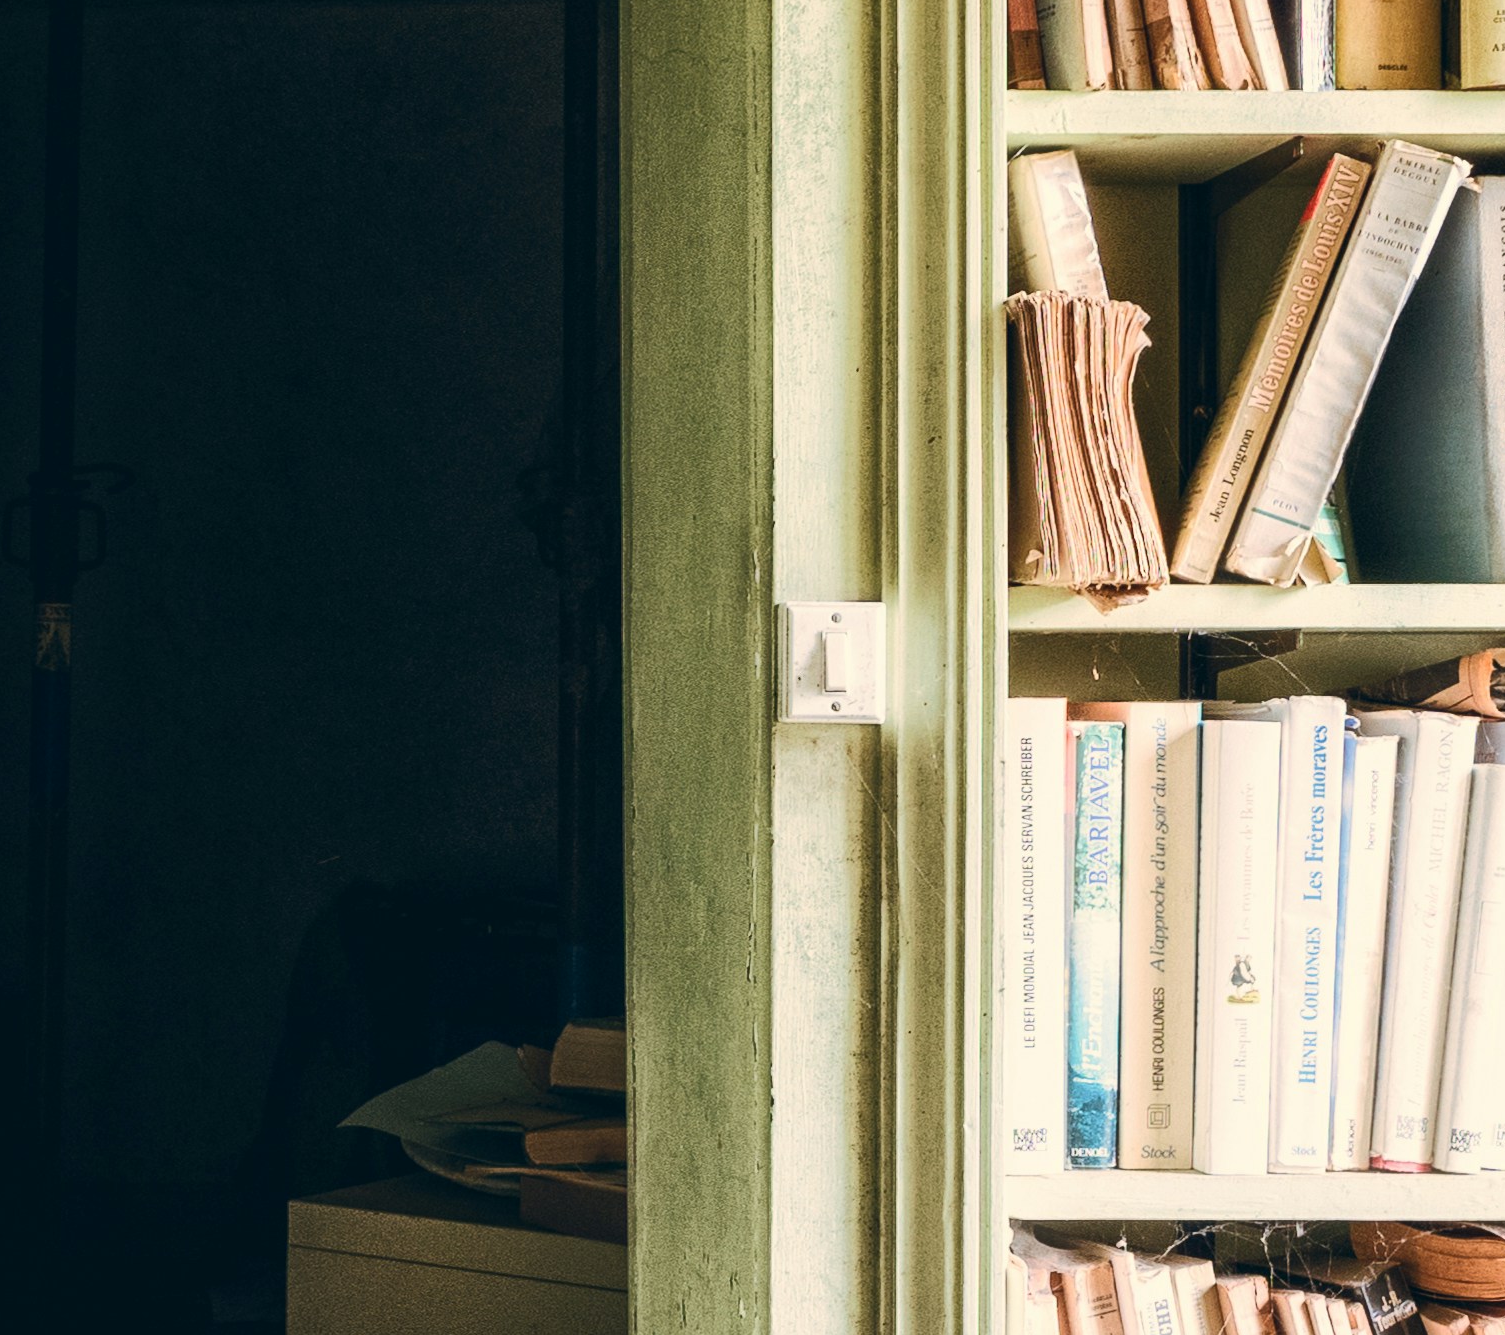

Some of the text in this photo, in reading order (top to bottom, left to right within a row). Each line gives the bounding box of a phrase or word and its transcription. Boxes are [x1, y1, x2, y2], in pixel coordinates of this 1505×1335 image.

[1247, 163, 1360, 413] Mémoires de Louis XIV
[1208, 428, 1255, 523] Jean Longnon
[1087, 736, 1111, 886] BARJAVEL
[1297, 724, 1329, 1084] HENRI COULONGES Les Frères moraves
